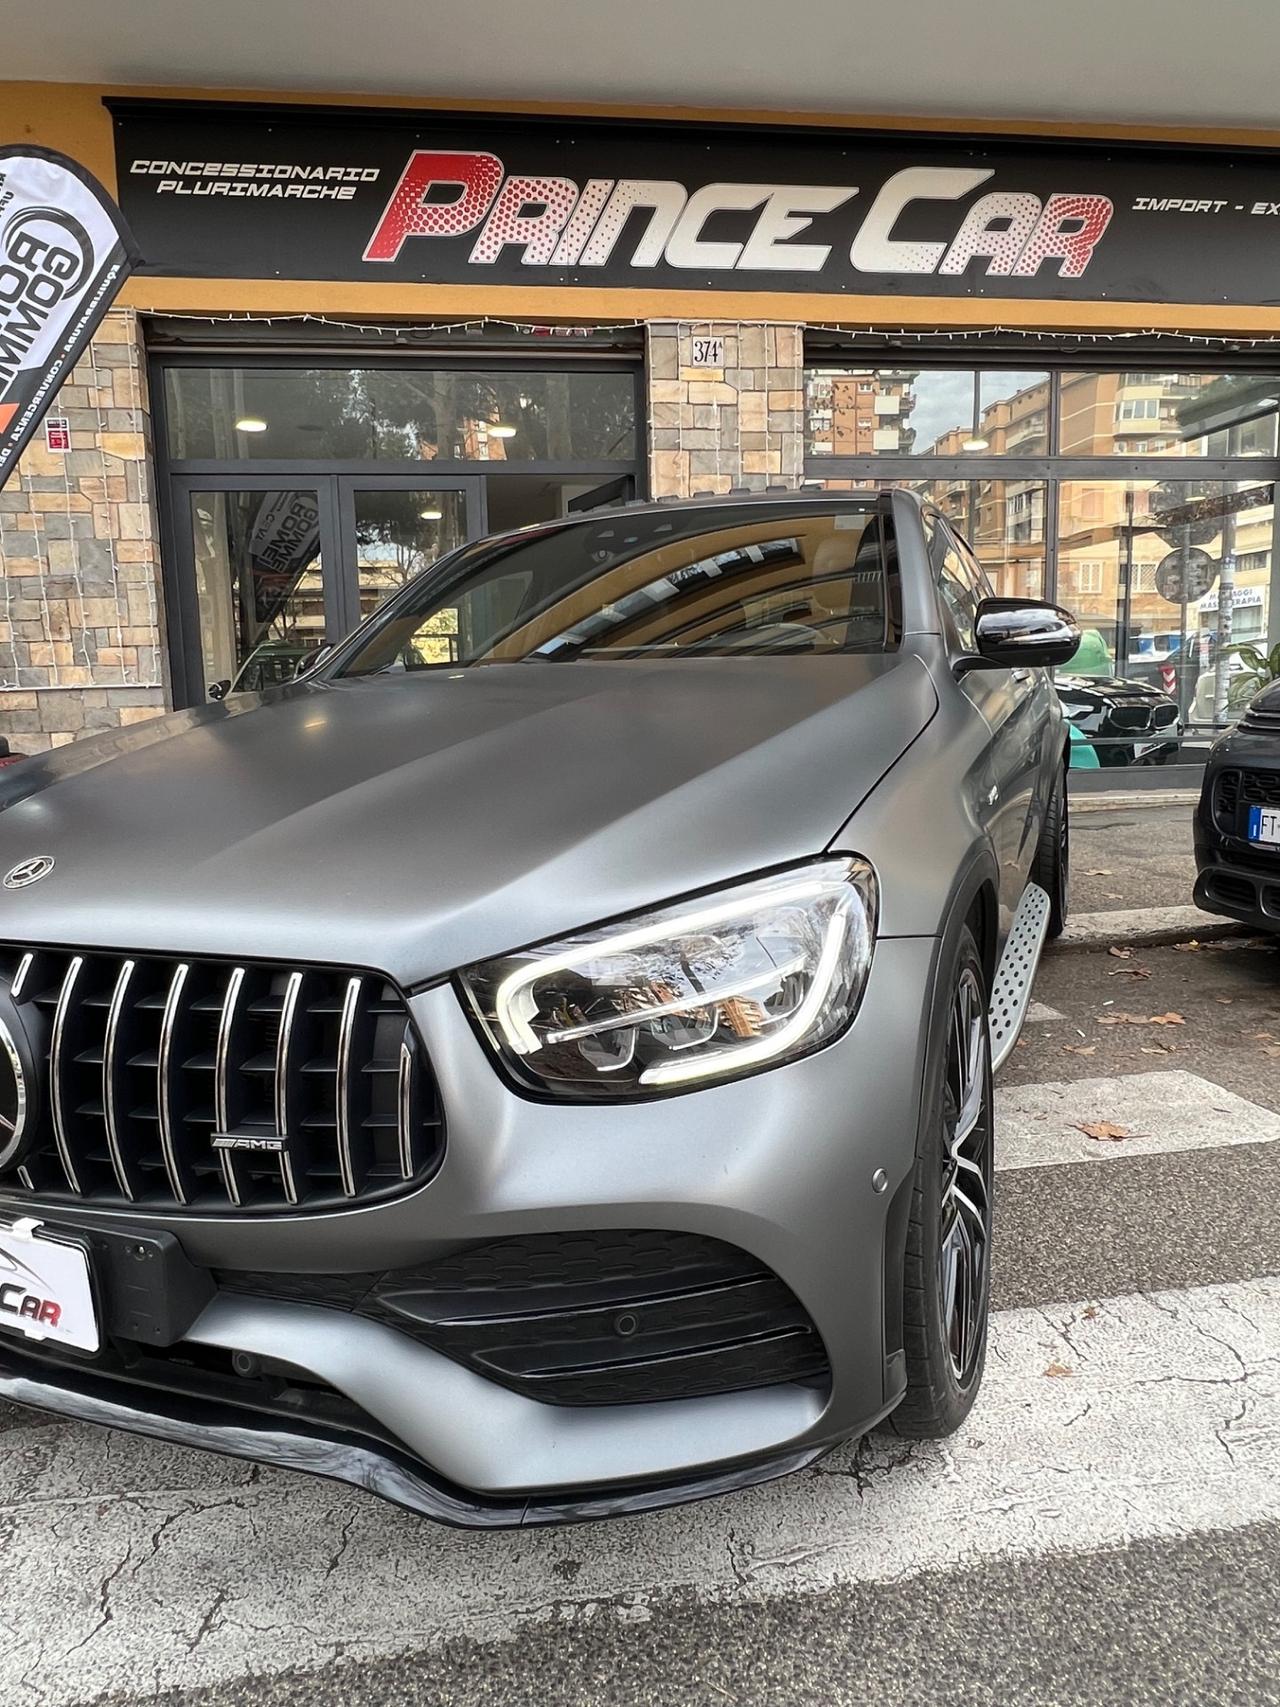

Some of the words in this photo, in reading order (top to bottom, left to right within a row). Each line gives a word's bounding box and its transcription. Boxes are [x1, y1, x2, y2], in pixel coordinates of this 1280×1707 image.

[130, 160, 380, 182] CONCESSIONARIO
[156, 180, 357, 200] PLURIMARCHE
[362, 149, 859, 271] PRINCE
[850, 166, 1114, 278] CAR
[1132, 197, 1228, 213] IMPORT
[1250, 202, 1280, 216] EX
[233, 1139, 283, 1151] AMG
[0, 1282, 62, 1328] CAR
